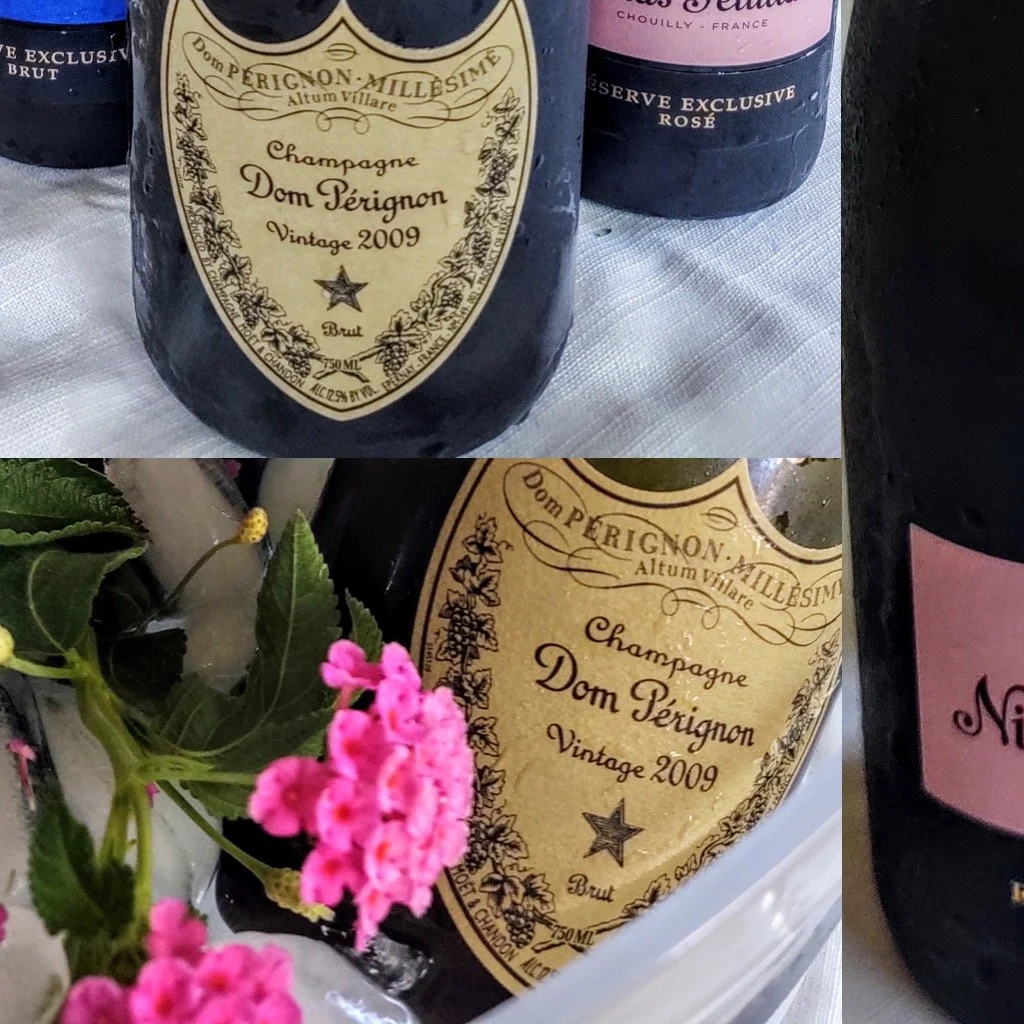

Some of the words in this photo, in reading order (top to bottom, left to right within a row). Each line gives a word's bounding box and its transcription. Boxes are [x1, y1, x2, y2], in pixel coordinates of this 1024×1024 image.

[616, 10, 693, 30] CHOUILLY
[712, 19, 769, 31] FRANCE
[7, 63, 59, 80] BRUT
[191, 36, 225, 74] Dom
[286, 89, 338, 109] Altum
[340, 89, 399, 113] Villare
[680, 84, 797, 112] EXCLUSIVE
[658, 112, 716, 129] ROSÉ
[266, 140, 420, 176] Champagne
[239, 163, 313, 208] Dom
[316, 178, 448, 224] Pérignon
[266, 220, 353, 256] Vintage
[357, 226, 421, 250] 2009
[207, 268, 241, 320] CHAMPAGNE
[263, 351, 307, 388] CHANDON
[321, 321, 363, 337] Brut
[343, 358, 362, 371] ML
[418, 336, 448, 365] FRANCE
[521, 468, 564, 520] Dom
[729, 554, 843, 609] MILLÉSIM
[634, 560, 698, 581] Altum
[702, 569, 754, 611] Villare
[585, 615, 749, 691] Champagne
[534, 642, 620, 714] Dom
[630, 678, 755, 754] Pérignon
[546, 722, 645, 783] Vintage
[650, 755, 719, 793] 2009
[567, 873, 617, 903] Brut
[467, 898, 481, 908] &
[474, 907, 520, 962] CHANDON
[551, 925, 575, 943] 750
